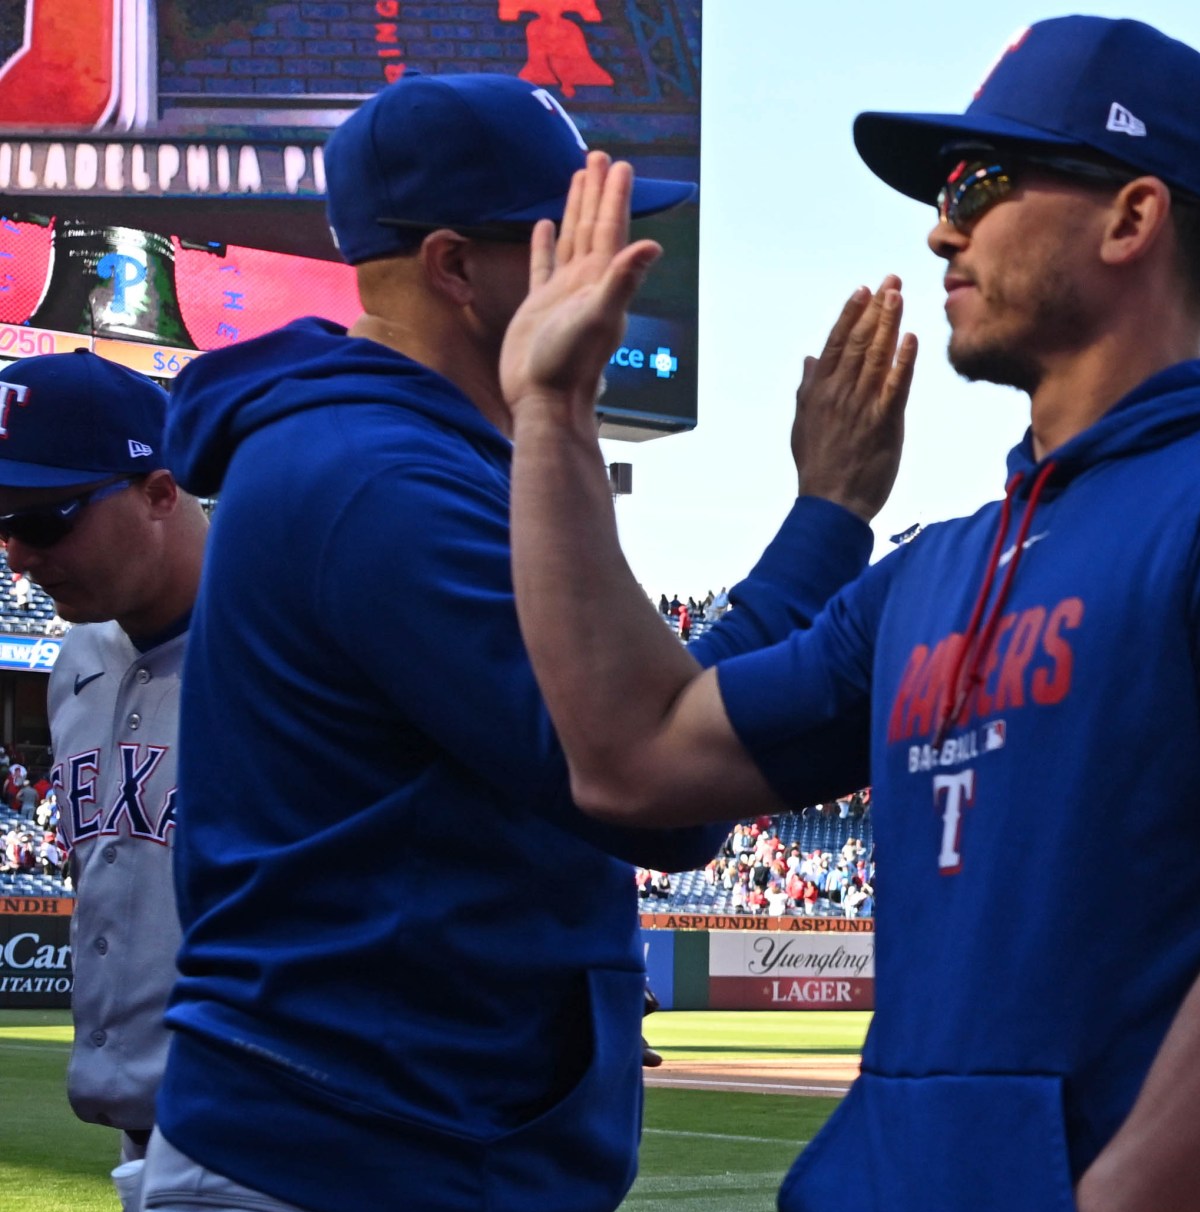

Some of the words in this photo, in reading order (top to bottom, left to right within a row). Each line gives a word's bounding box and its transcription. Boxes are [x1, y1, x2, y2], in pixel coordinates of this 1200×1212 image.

[933, 768, 977, 877] T
[665, 915, 768, 931] ASPLUNDH
[748, 936, 870, 977] Yuengling
[771, 981, 852, 1003] LAGER
